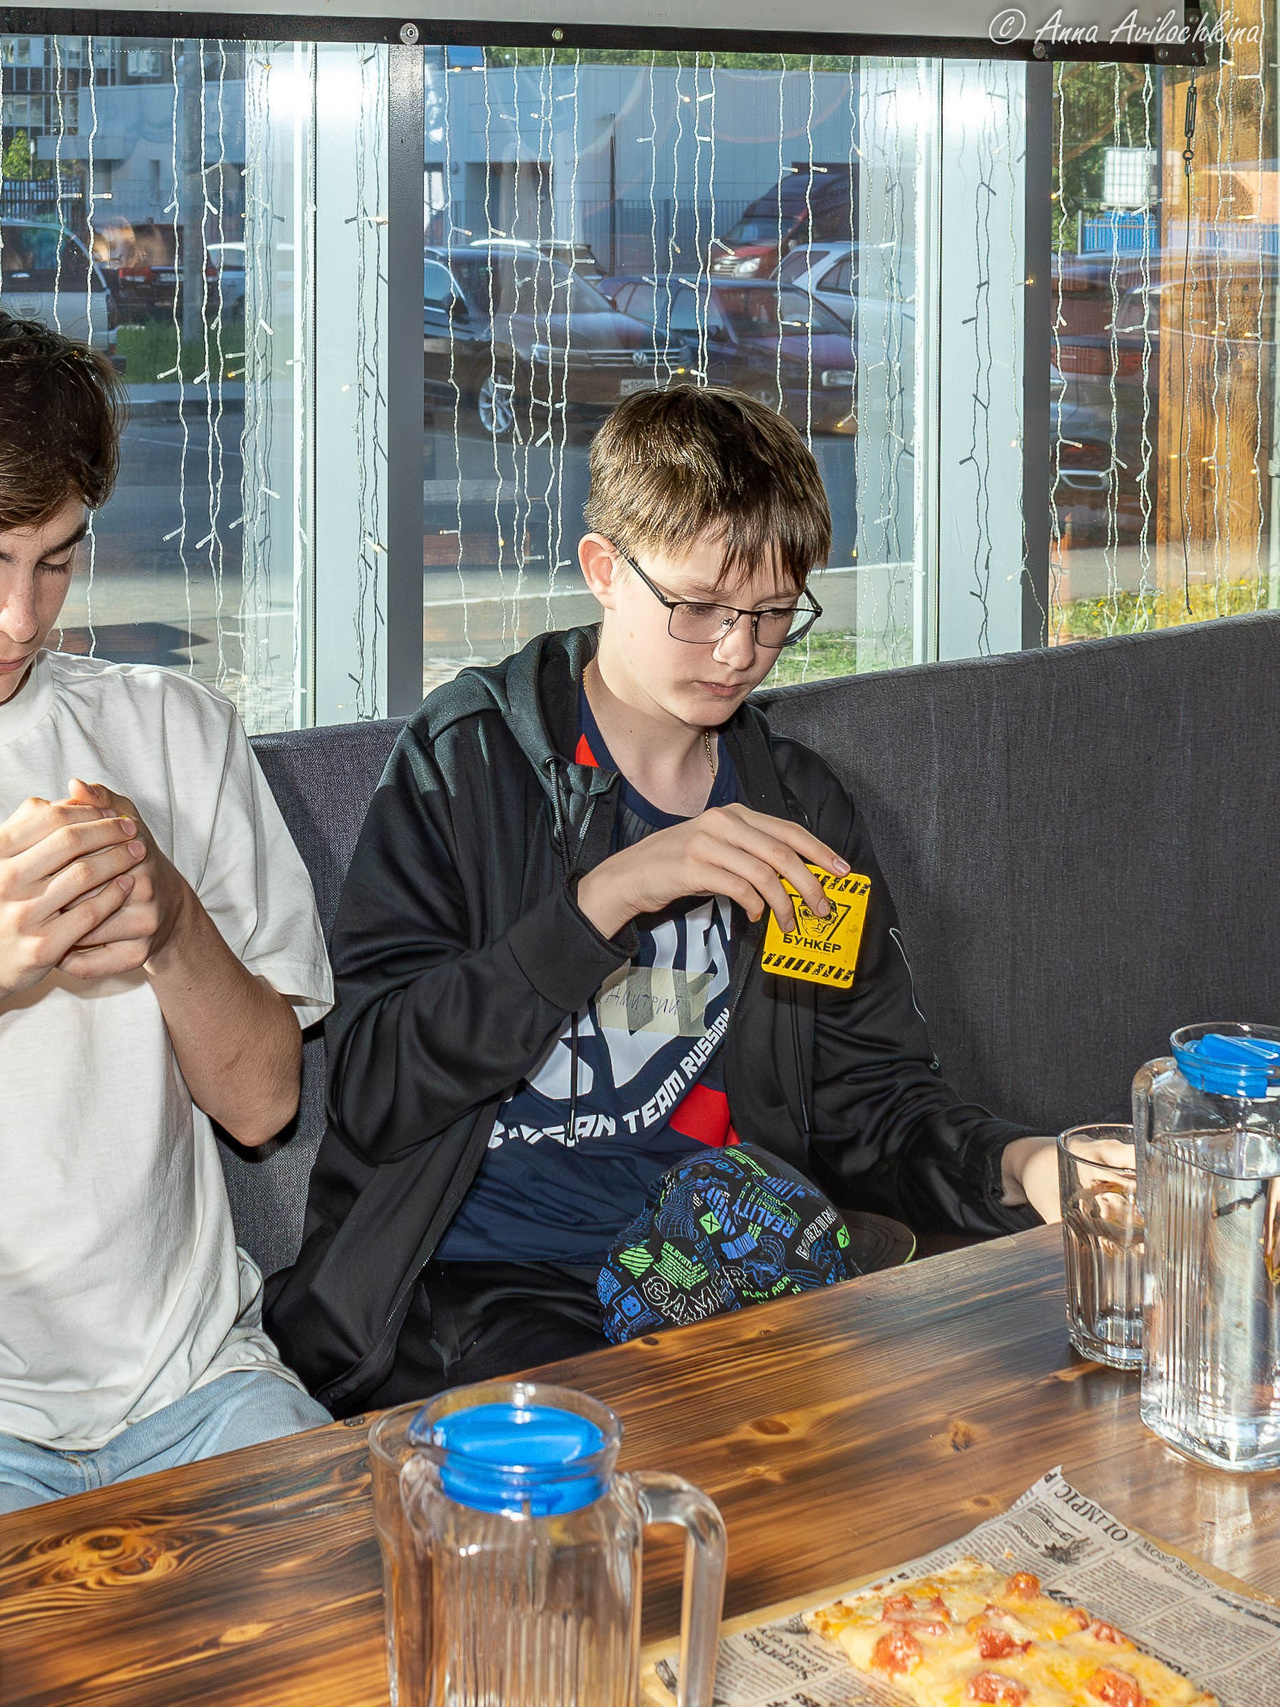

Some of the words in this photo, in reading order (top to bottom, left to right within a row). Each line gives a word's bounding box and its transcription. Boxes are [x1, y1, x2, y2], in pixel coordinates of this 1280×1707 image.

[782, 933, 842, 953] БУНКЕР
[622, 1069, 686, 1134] TEAM
[731, 1198, 796, 1239] REALITY
[742, 1289, 769, 1299] PLAY
